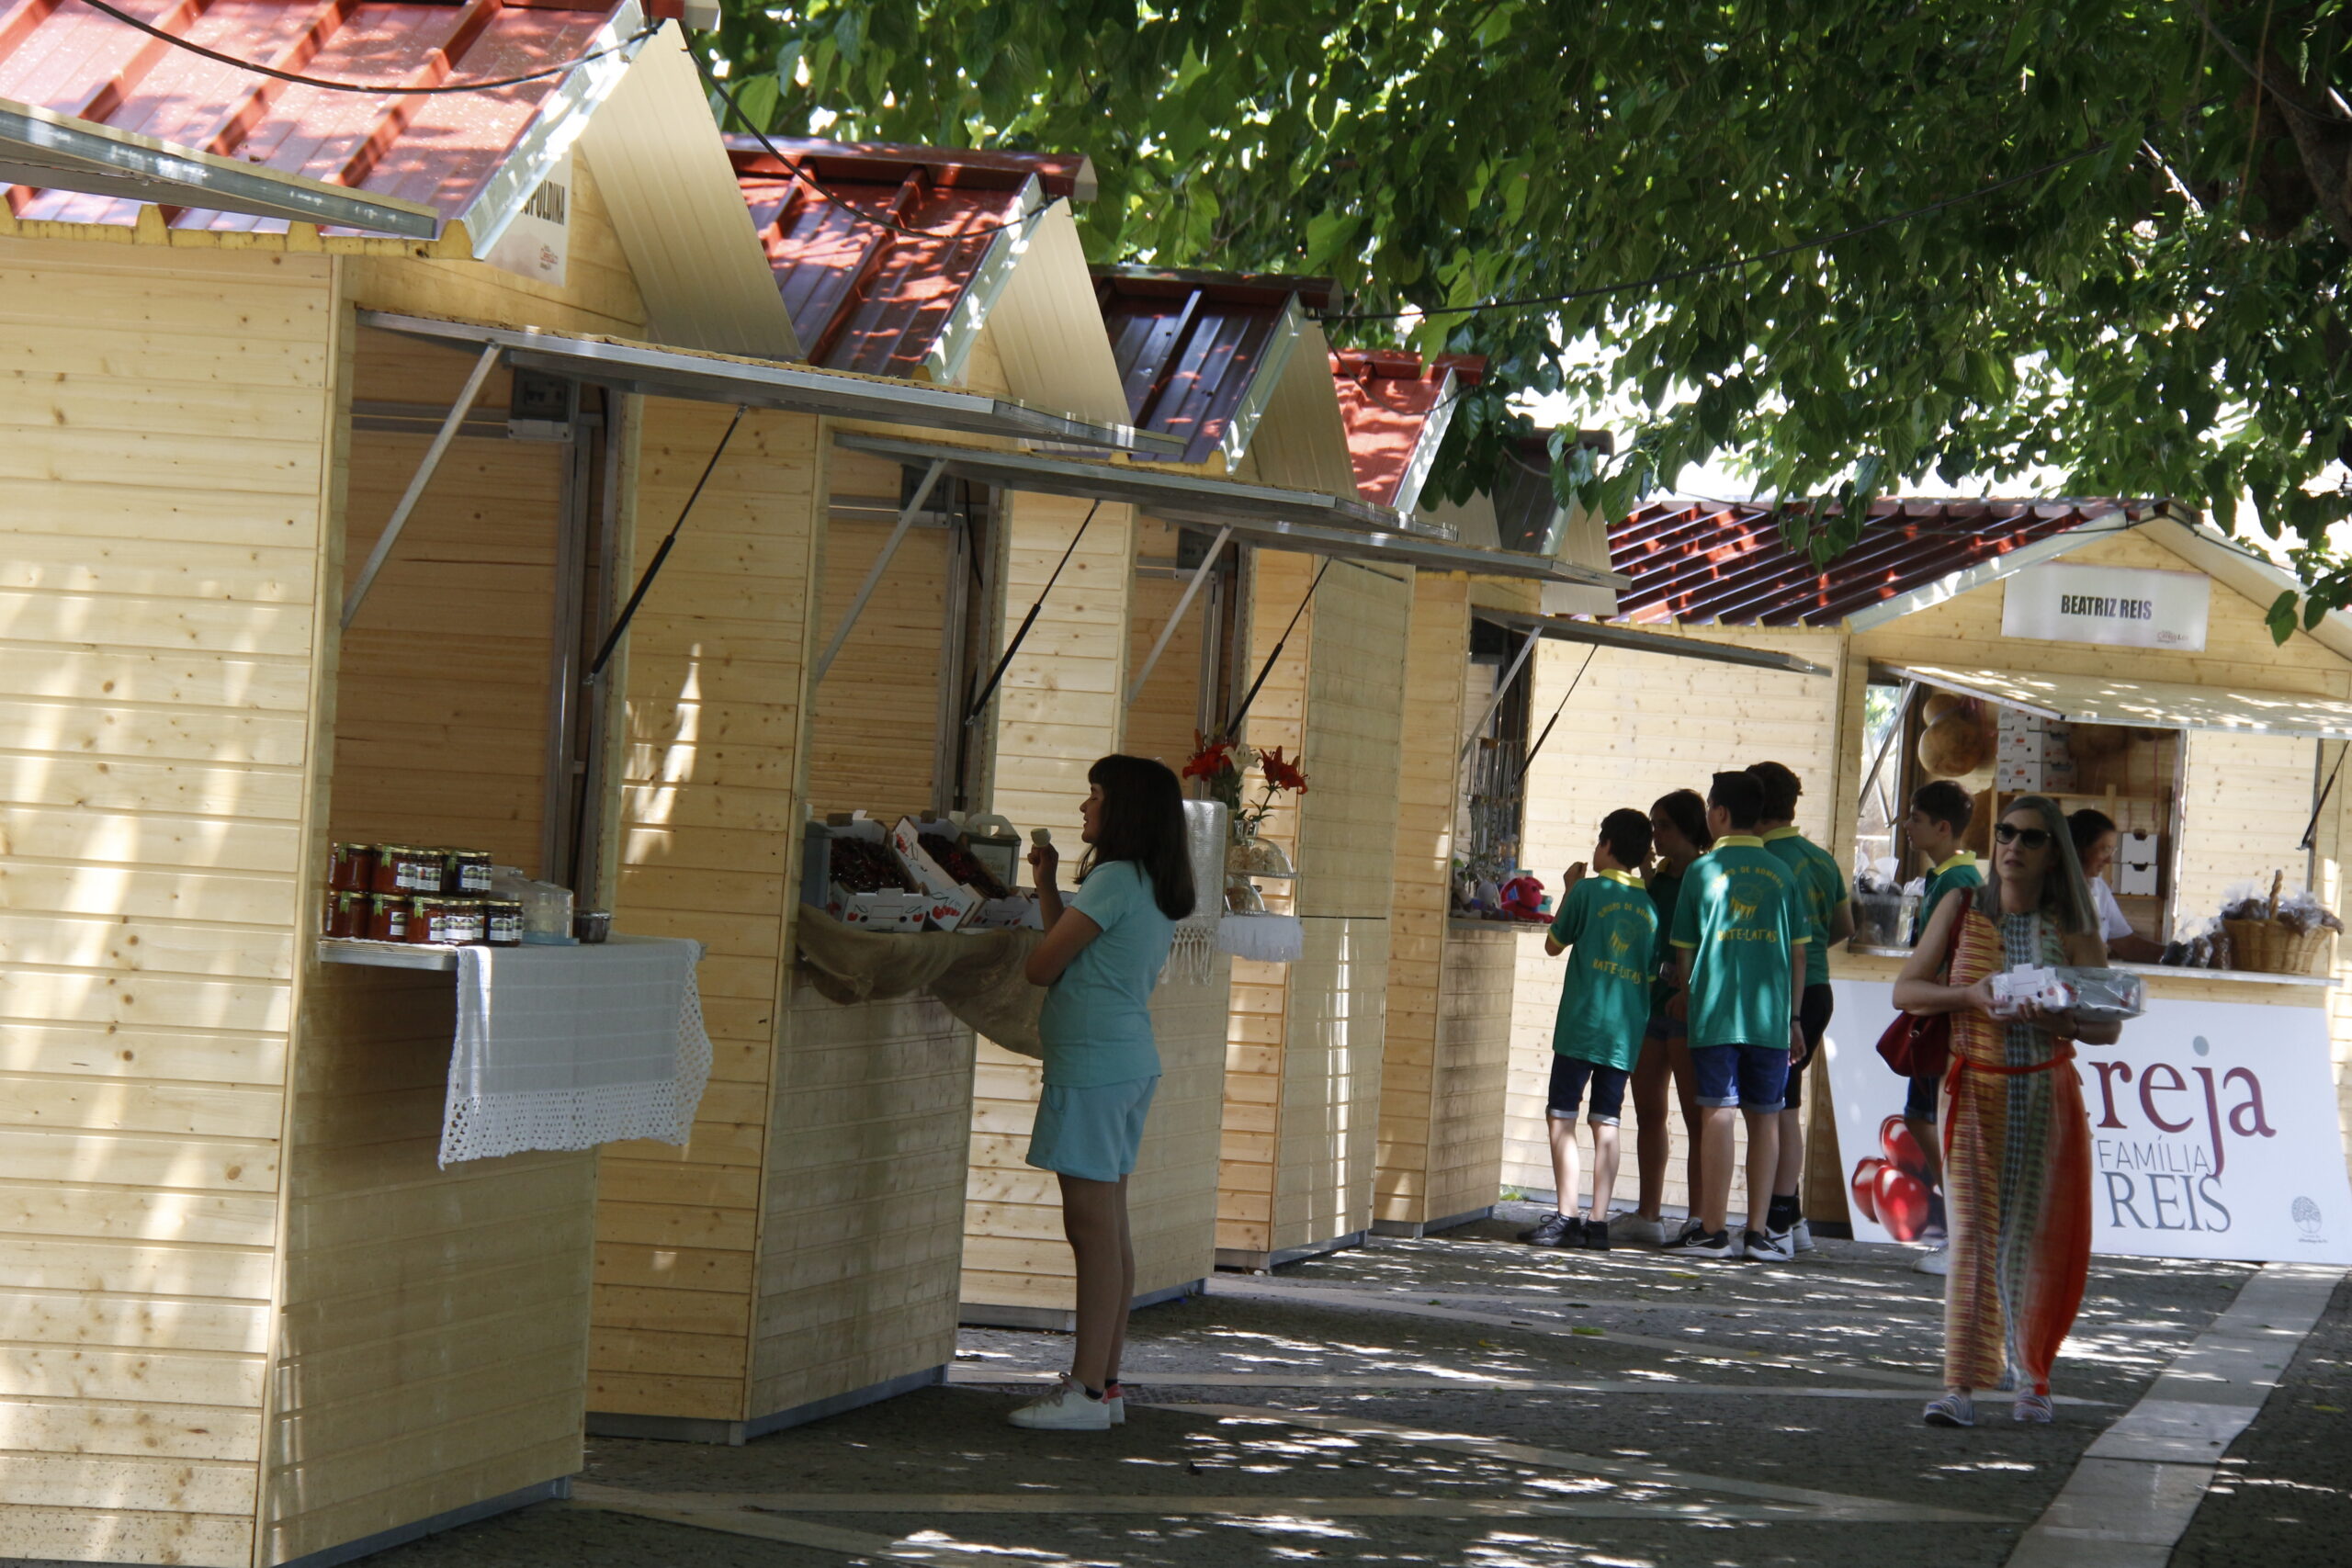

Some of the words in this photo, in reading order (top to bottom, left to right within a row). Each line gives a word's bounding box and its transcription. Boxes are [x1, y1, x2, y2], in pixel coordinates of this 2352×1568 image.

[2061, 594, 2118, 618] BEATRIZ
[2120, 599, 2153, 620] REIS
[2084, 1035, 2277, 1178] reja
[2098, 1134, 2210, 1173] FAMÍLIA
[2101, 1171, 2233, 1234] REIS
